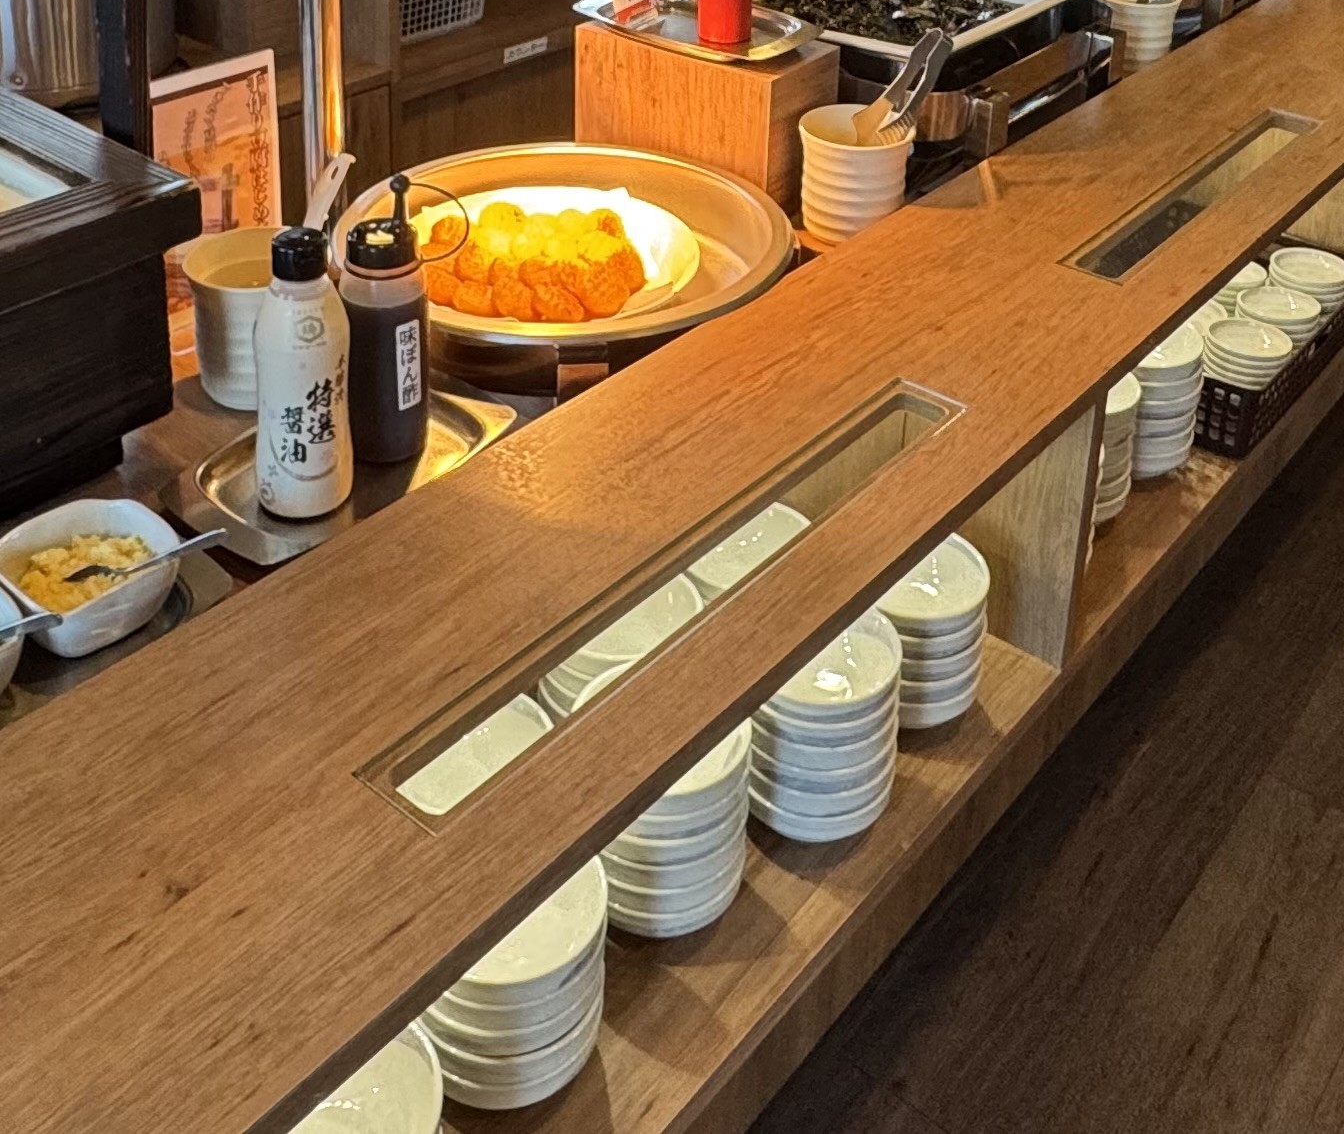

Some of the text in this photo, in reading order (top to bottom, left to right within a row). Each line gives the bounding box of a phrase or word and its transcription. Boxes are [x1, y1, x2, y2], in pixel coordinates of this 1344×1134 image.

[399, 326, 418, 406] 味ぽん酢
[280, 406, 307, 464] 醤油
[306, 378, 337, 444] 特選
